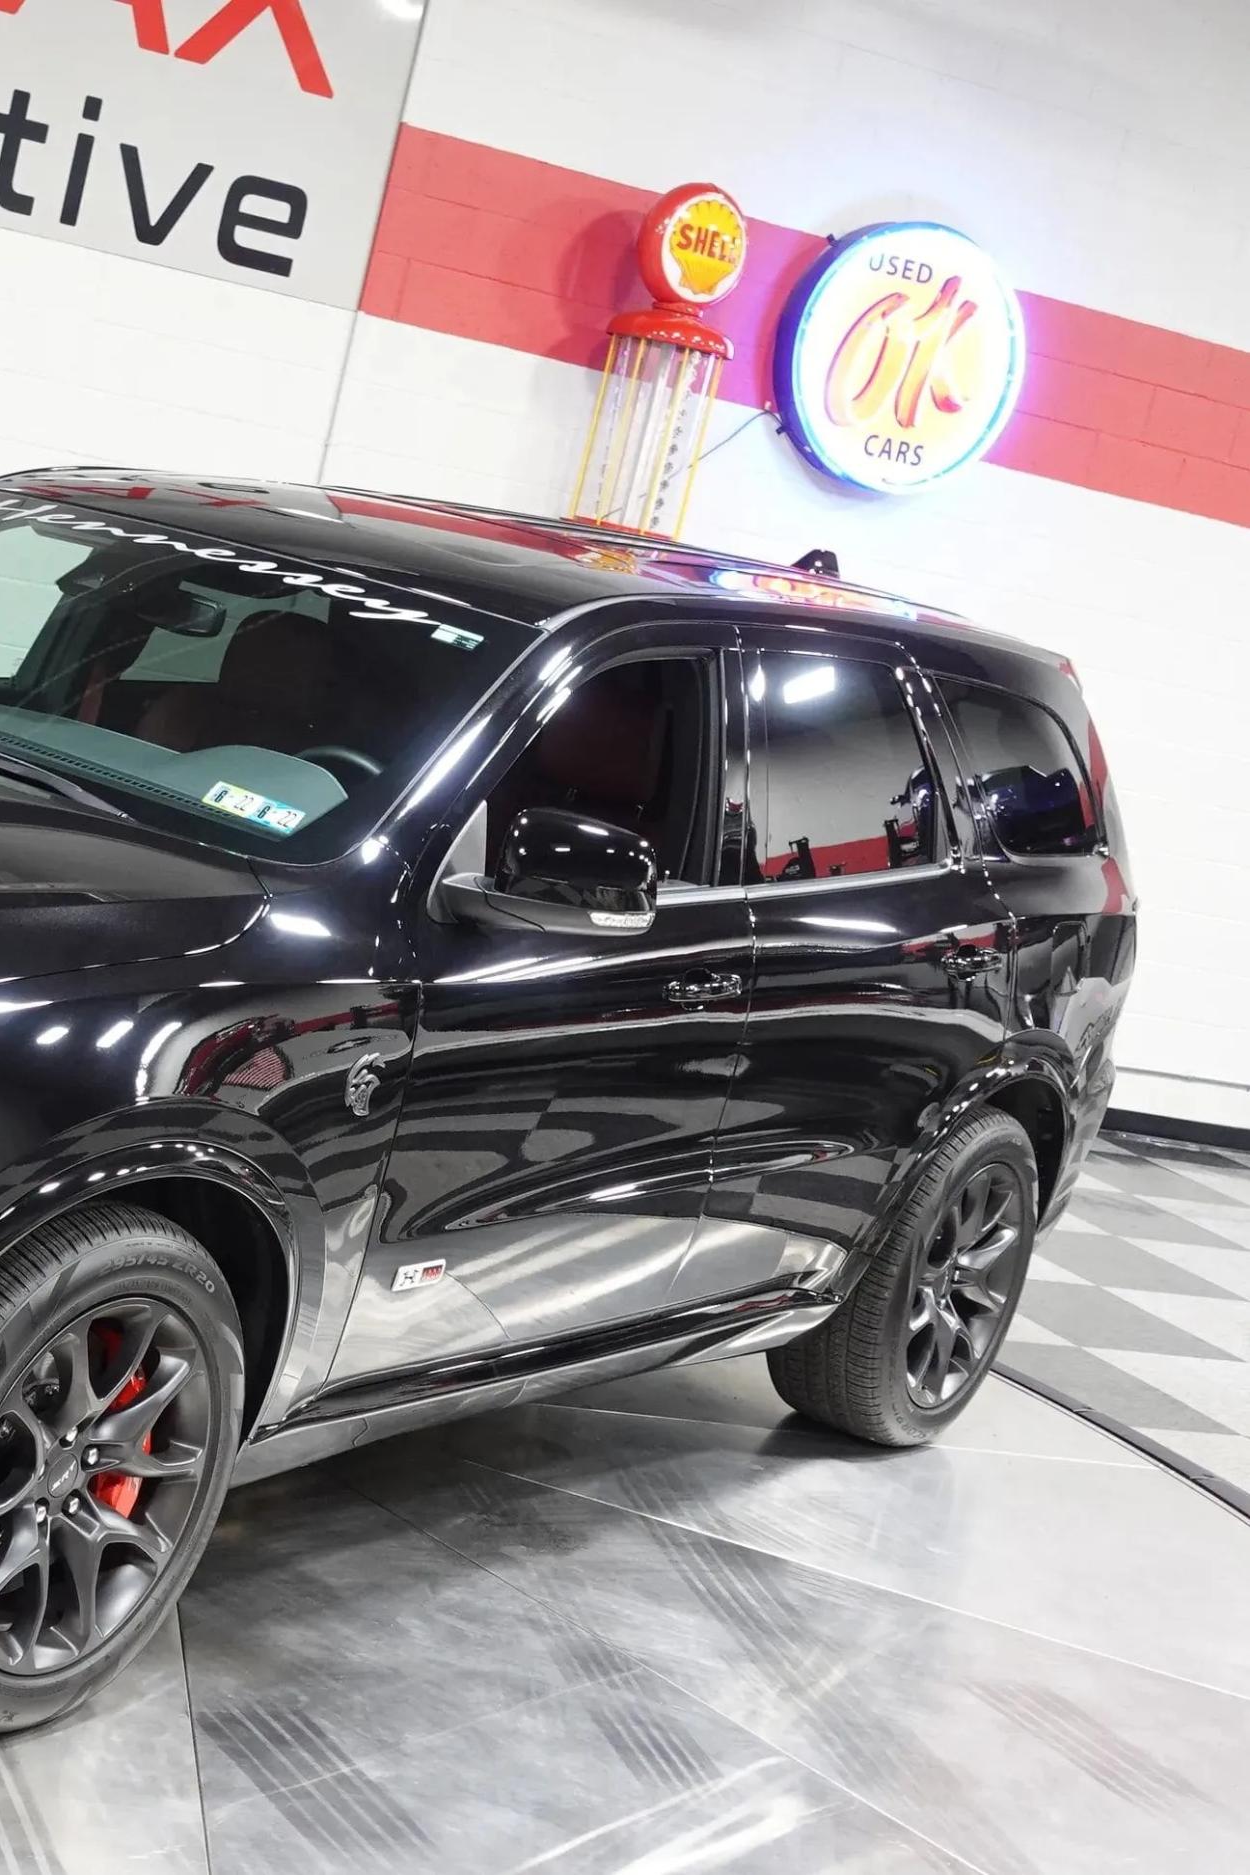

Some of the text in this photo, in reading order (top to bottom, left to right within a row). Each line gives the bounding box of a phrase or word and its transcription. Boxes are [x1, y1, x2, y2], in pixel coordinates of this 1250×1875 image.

[869, 253, 933, 284] USED
[824, 275, 978, 429] OK
[864, 434, 924, 466] CARS
